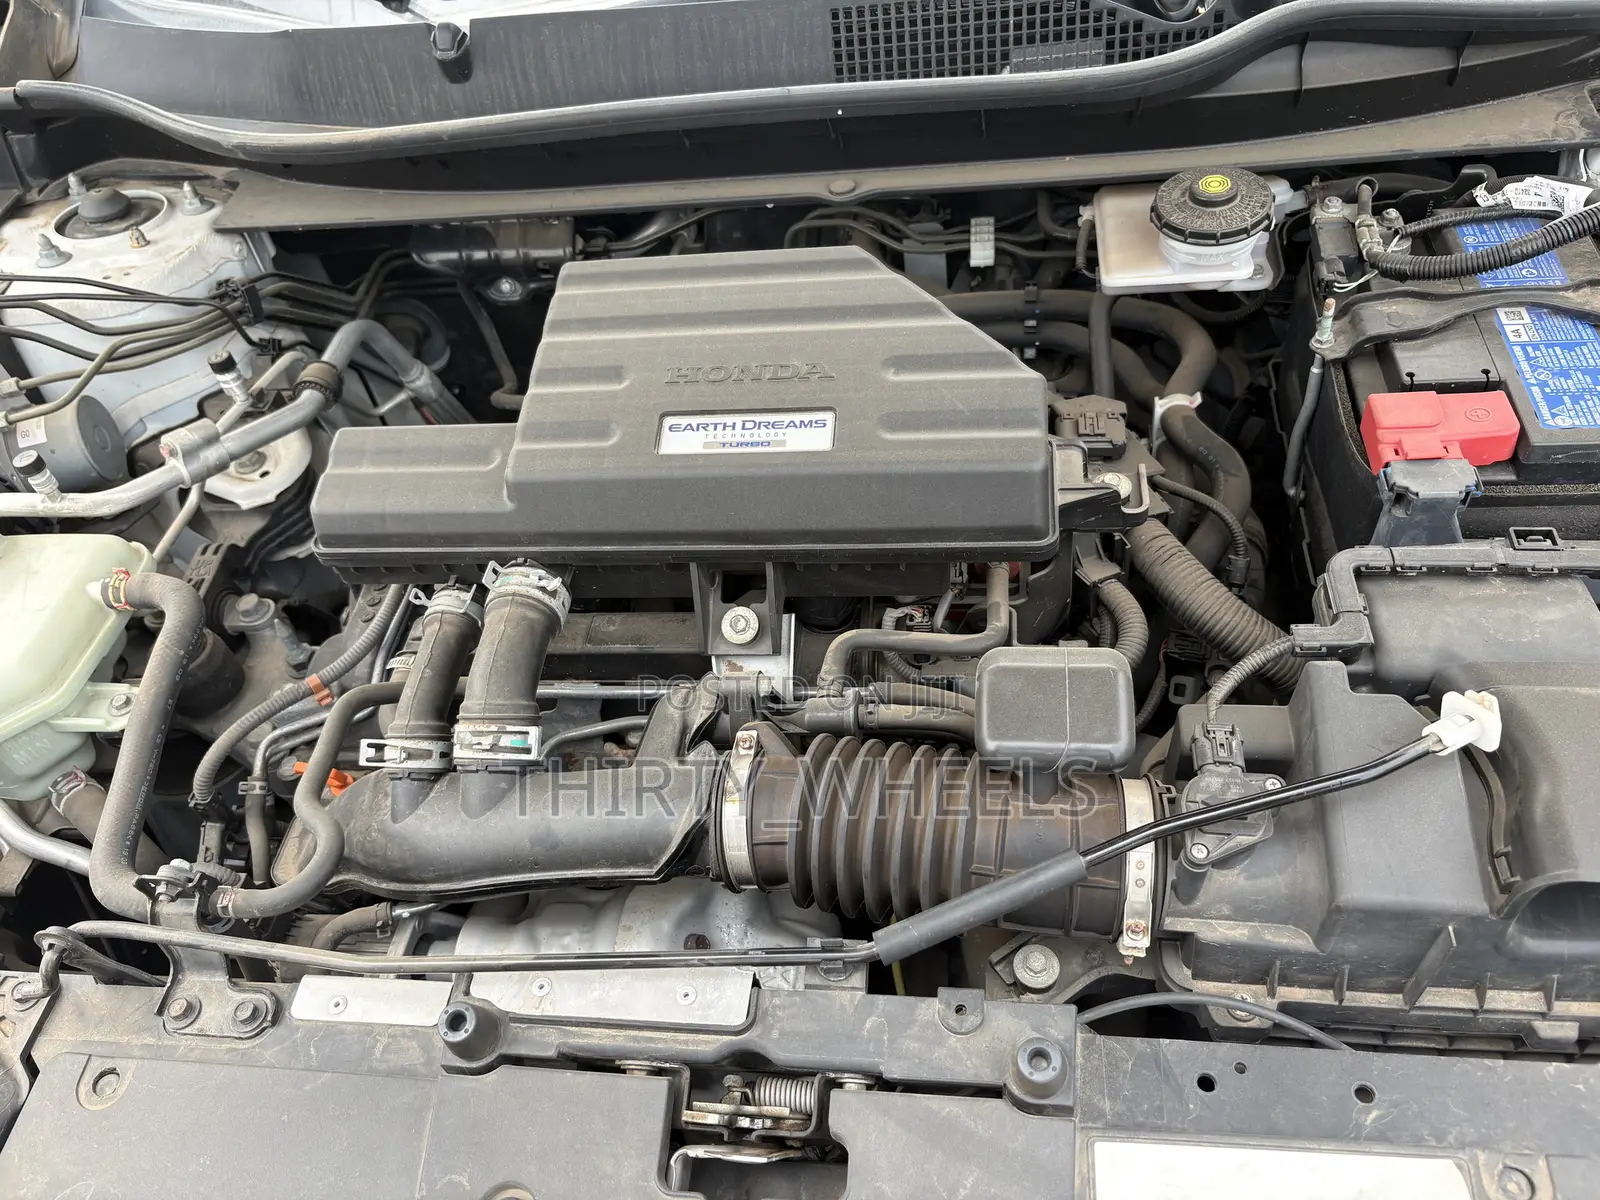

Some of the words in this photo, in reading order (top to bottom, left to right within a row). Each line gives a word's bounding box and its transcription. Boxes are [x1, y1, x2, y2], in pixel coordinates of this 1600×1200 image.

[665, 362, 835, 384] HONDA
[668, 422, 736, 433] EARTH
[741, 419, 828, 432] DREAMS
[719, 440, 772, 448] TURBO
